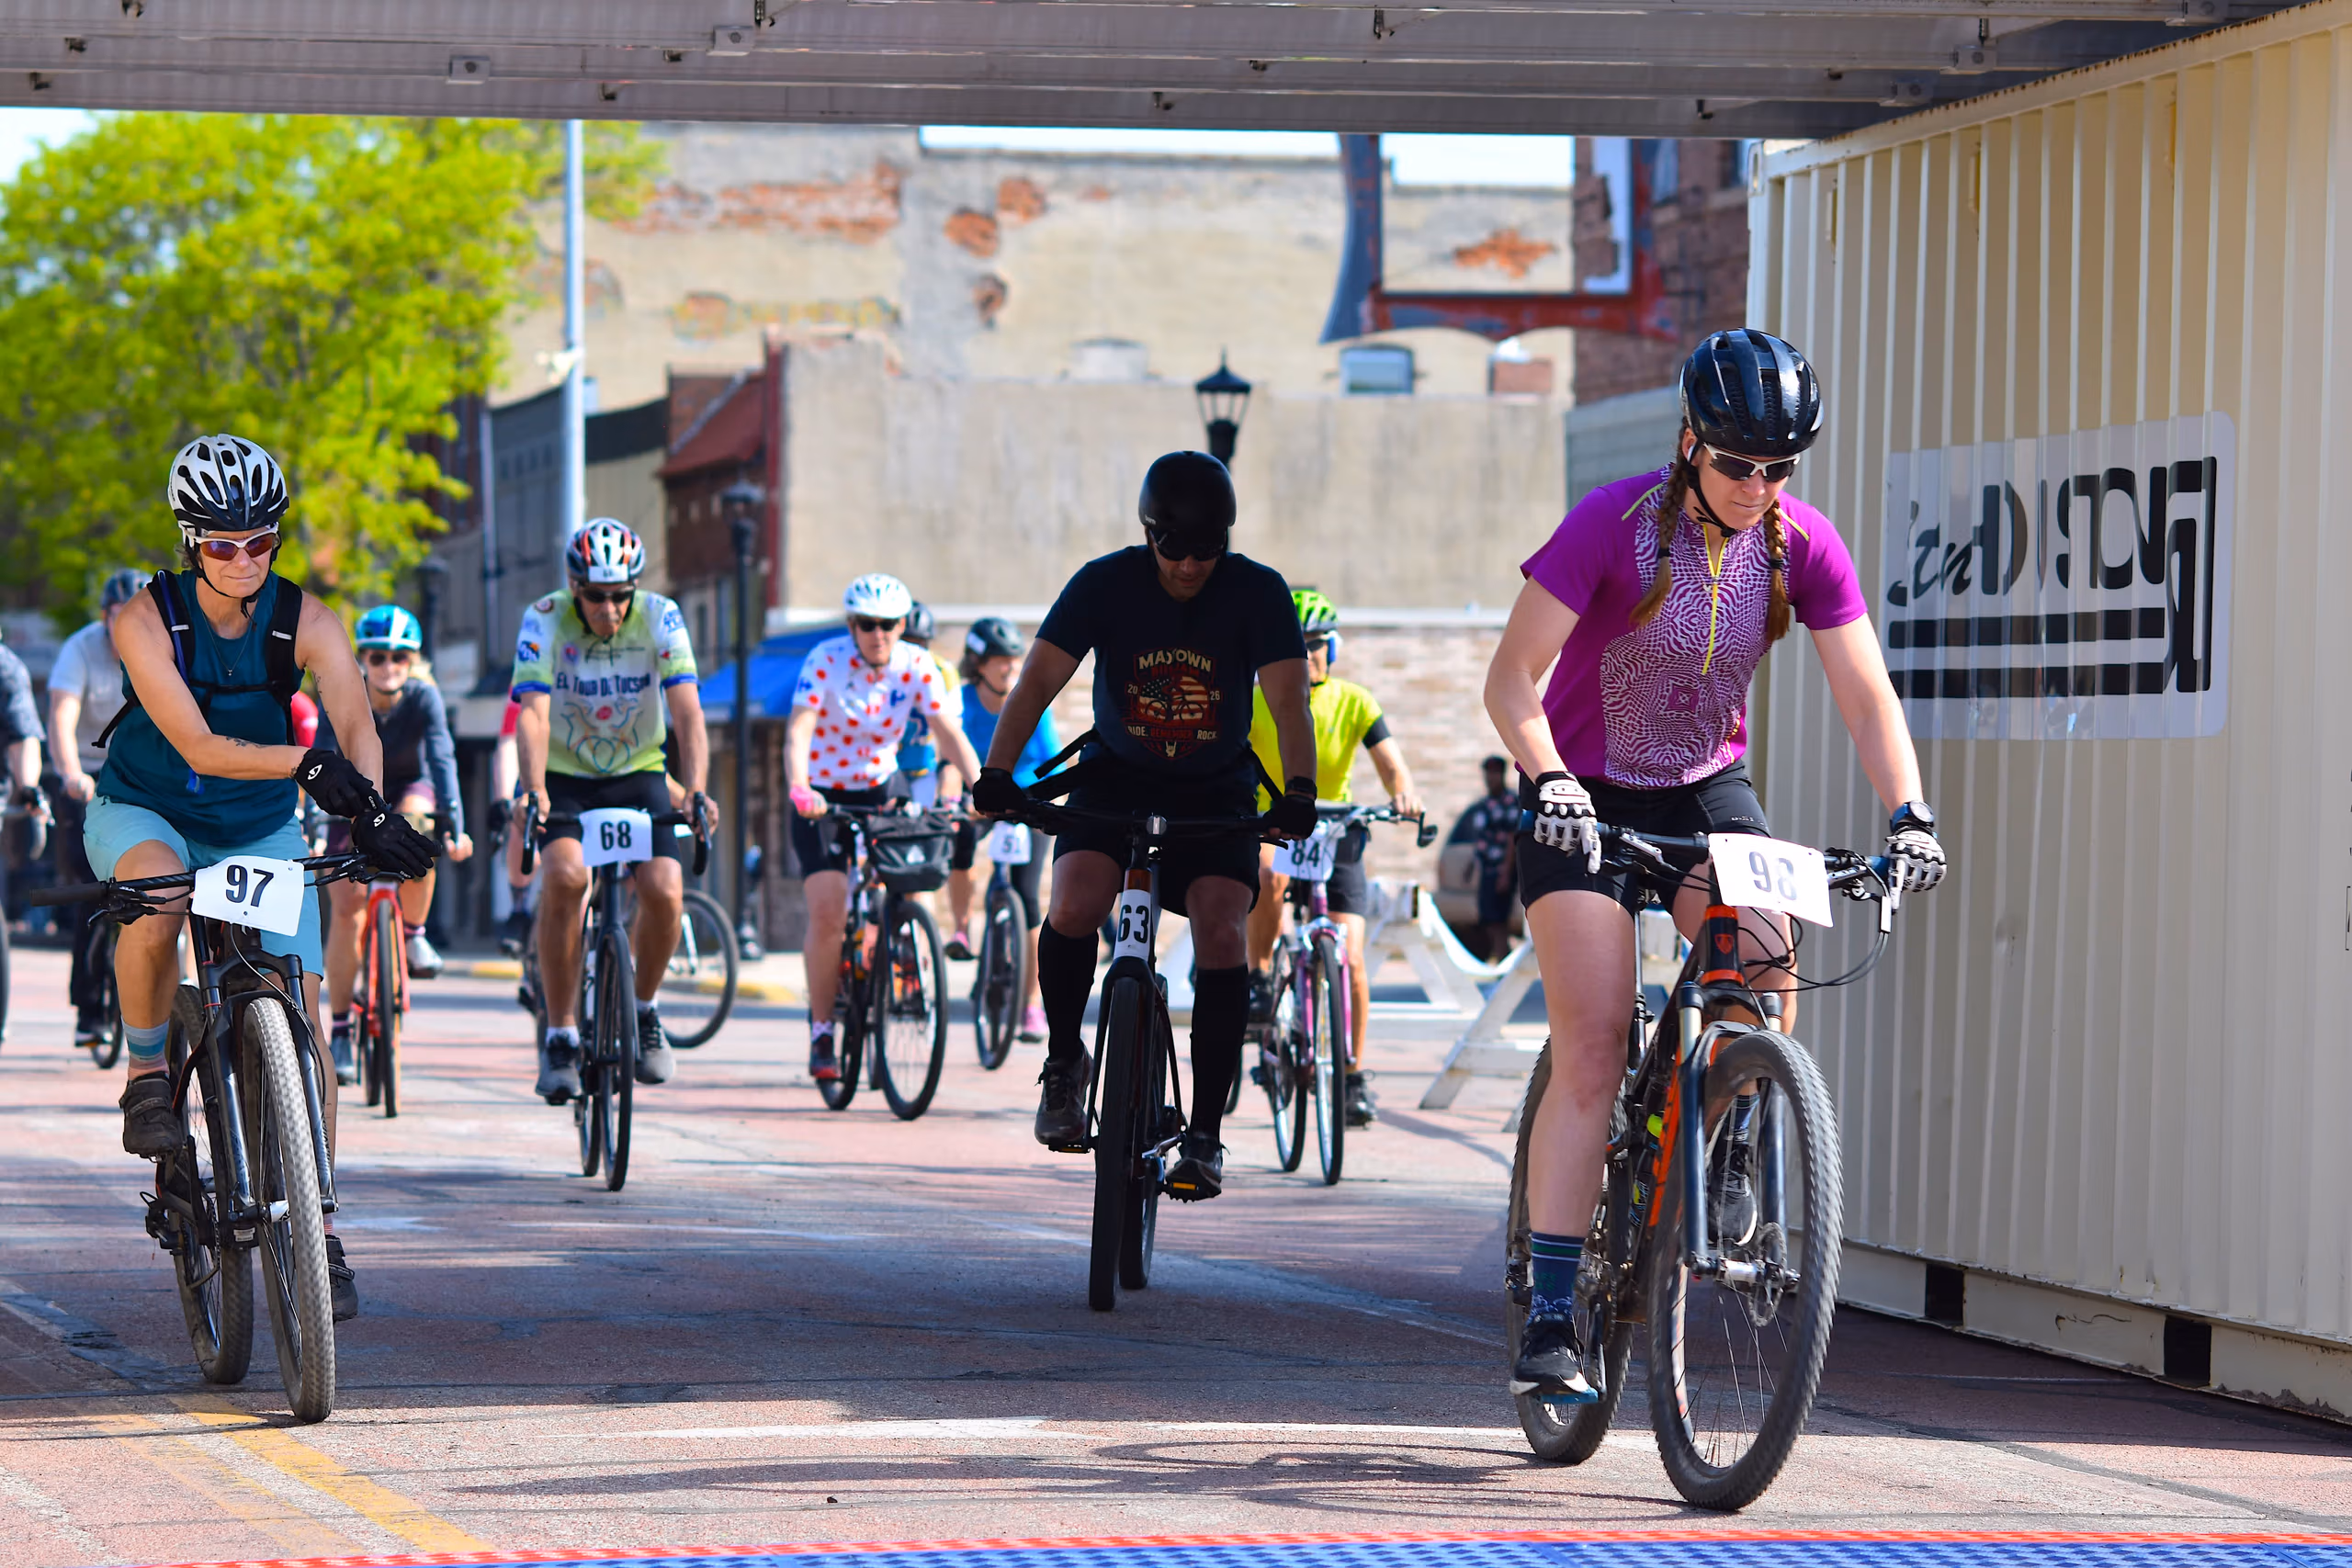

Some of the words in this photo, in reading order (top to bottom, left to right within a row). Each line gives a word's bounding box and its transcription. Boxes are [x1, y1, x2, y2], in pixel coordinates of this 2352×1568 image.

[1127, 683, 1138, 695] 20
[1209, 690, 1220, 701] 26
[600, 820, 632, 852] 68
[1291, 840, 1320, 868] 84
[225, 864, 275, 908] 97
[1748, 851, 1797, 900] 98
[1117, 904, 1149, 944] 63
